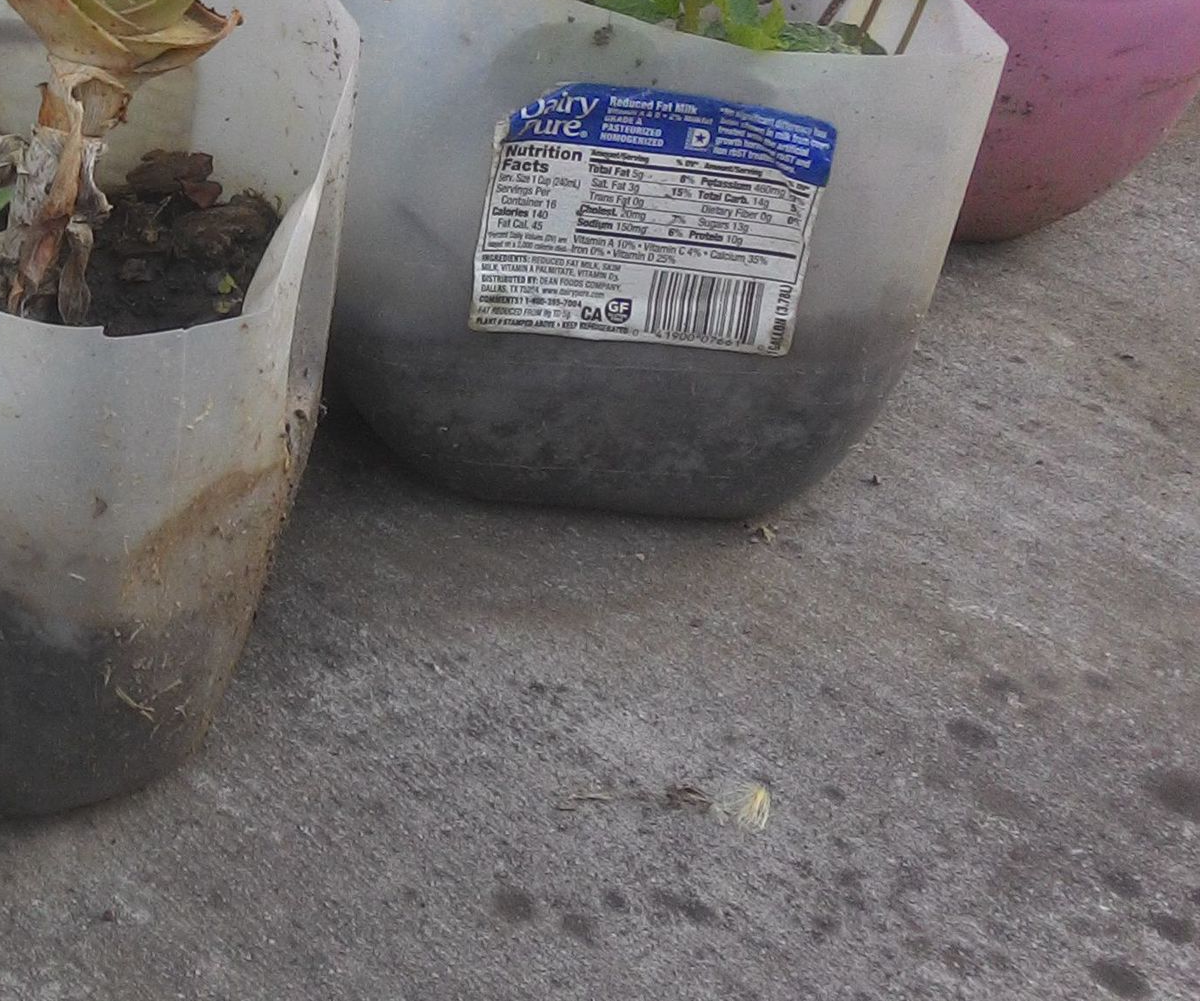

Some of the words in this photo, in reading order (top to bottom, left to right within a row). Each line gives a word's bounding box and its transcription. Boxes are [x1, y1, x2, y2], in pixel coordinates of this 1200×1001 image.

[610, 96, 654, 110] Reduced
[655, 99, 673, 112] Fat
[675, 101, 698, 115] Milk
[602, 124, 662, 137] PASTEURIZED
[600, 132, 664, 147] HOMOGENIZED
[506, 144, 583, 161] Nutrition
[502, 158, 549, 173] Facts
[589, 164, 612, 175] Total
[614, 167, 630, 178] Fat
[631, 170, 644, 180] 5g
[496, 184, 533, 196] Servings
[535, 186, 551, 196] Per
[591, 178, 608, 187] Sat.
[611, 180, 627, 190] Fat
[628, 182, 640, 195] 3g
[671, 188, 692, 198] 15%
[701, 177, 752, 191] Potassium
[501, 195, 544, 207] Container
[589, 191, 614, 203] Trans
[616, 194, 630, 206] Fat
[631, 196, 645, 208] 0g
[698, 190, 722, 201] Total
[724, 193, 749, 204] Carb.
[492, 206, 529, 217] Calories
[531, 210, 549, 219] 140
[701, 204, 733, 218] Dietary
[735, 208, 759, 220] Fiber
[498, 218, 511, 228] Fat
[531, 221, 543, 230] 45
[577, 217, 613, 229] Sodium
[616, 222, 648, 235] 150mg
[698, 217, 729, 230] Sugars
[689, 230, 723, 242] Protein
[572, 244, 588, 256] Iron
[590, 246, 605, 256] 0%
[613, 249, 645, 261] Vitamin
[573, 235, 606, 247] Vitamin
[617, 239, 636, 250] 10%
[644, 242, 676, 254] Vitamin
[686, 247, 703, 257] 4%
[710, 250, 746, 262] Calcium
[747, 255, 768, 265] 35%
[581, 305, 602, 322] CA
[608, 301, 629, 313] GF
[767, 317, 787, 351] GALLON
